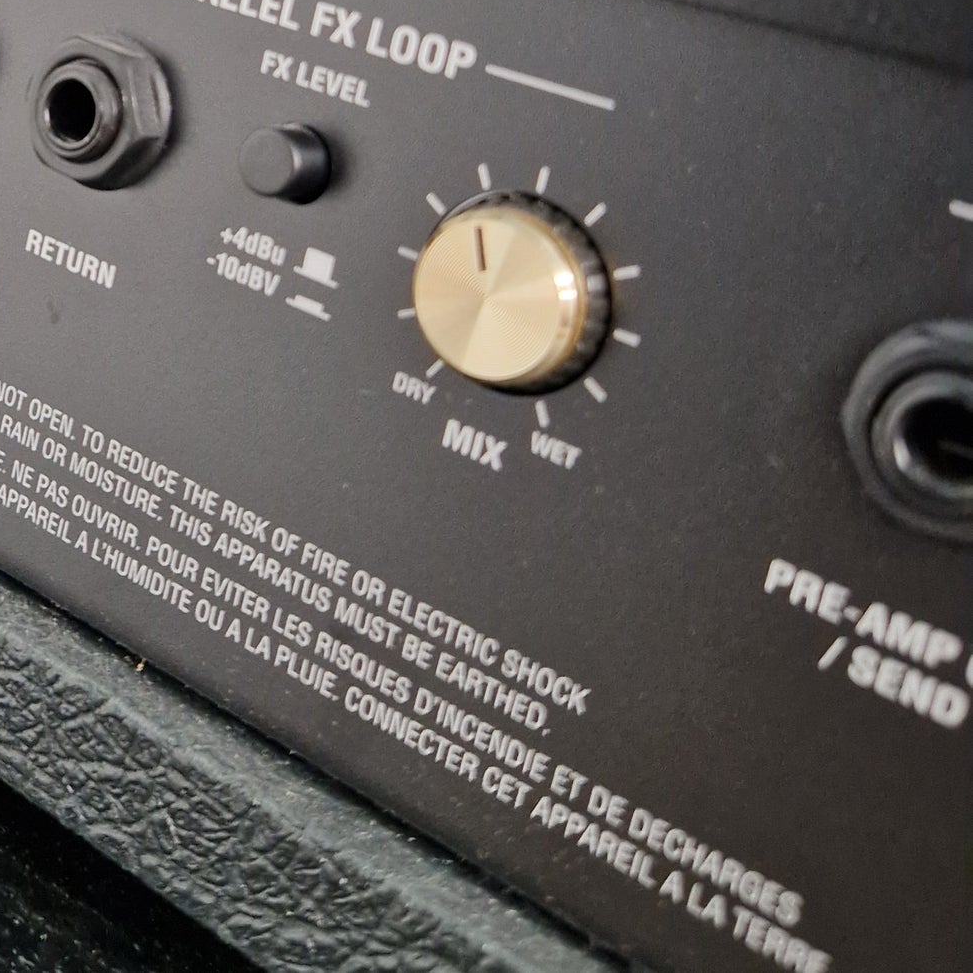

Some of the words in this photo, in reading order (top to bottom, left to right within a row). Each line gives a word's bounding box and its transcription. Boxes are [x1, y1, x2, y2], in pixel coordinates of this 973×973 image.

[310, 0, 363, 49] FX
[365, 16, 478, 80] LOOP
[259, 49, 292, 83] FX
[295, 61, 371, 109] LEVEL
[25, 228, 117, 289] RETURN
[206, 252, 282, 296] -10dBV
[219, 226, 288, 267] +4dBu
[391, 370, 438, 406] DRY
[441, 418, 509, 473] MIX
[530, 429, 583, 471] WET
[0, 414, 41, 452] RAIN
[42, 437, 68, 467] OR
[69, 451, 163, 522] MOISTURE.
[169, 504, 214, 547] THIS
[213, 532, 334, 613] APPARATUS
[334, 596, 402, 650] MUST
[401, 632, 437, 670] BE
[435, 651, 552, 737] EARTHED.
[28, 398, 76, 441] OPEN.
[82, 424, 104, 454] TO
[106, 438, 180, 495] REDUCE
[182, 477, 220, 516] THE
[220, 499, 271, 543] RISK
[271, 527, 302, 557] OF
[300, 542, 351, 587] FIRE
[351, 569, 387, 606] OR
[387, 588, 501, 667] ELECTRIC
[500, 648, 592, 716] SHOCK
[763, 557, 964, 670] PRE-AMP
[10, 459, 35, 489] NE
[35, 473, 70, 508] PAS
[71, 494, 142, 551] OUVRIR.
[145, 535, 200, 583] POUR
[200, 566, 271, 623] EVITER
[272, 607, 314, 648] LES
[314, 630, 414, 705] RISQUES
[413, 687, 552, 784] D'INCENDIE
[550, 764, 589, 802] ET
[587, 785, 629, 827] DE
[628, 808, 805, 927] DECHARGES
[847, 644, 971, 731] SEND
[74, 530, 89, 554] A
[90, 538, 195, 614] L'HUMIDITE
[194, 598, 226, 632] OU
[225, 617, 242, 643] A
[244, 627, 271, 661] LA
[274, 644, 340, 702] PLUIE.
[344, 686, 481, 783] CONNECTER
[481, 766, 534, 810] CET
[529, 795, 658, 890] APPAREIL
[658, 870, 686, 905] A
[685, 882, 727, 929] LA
